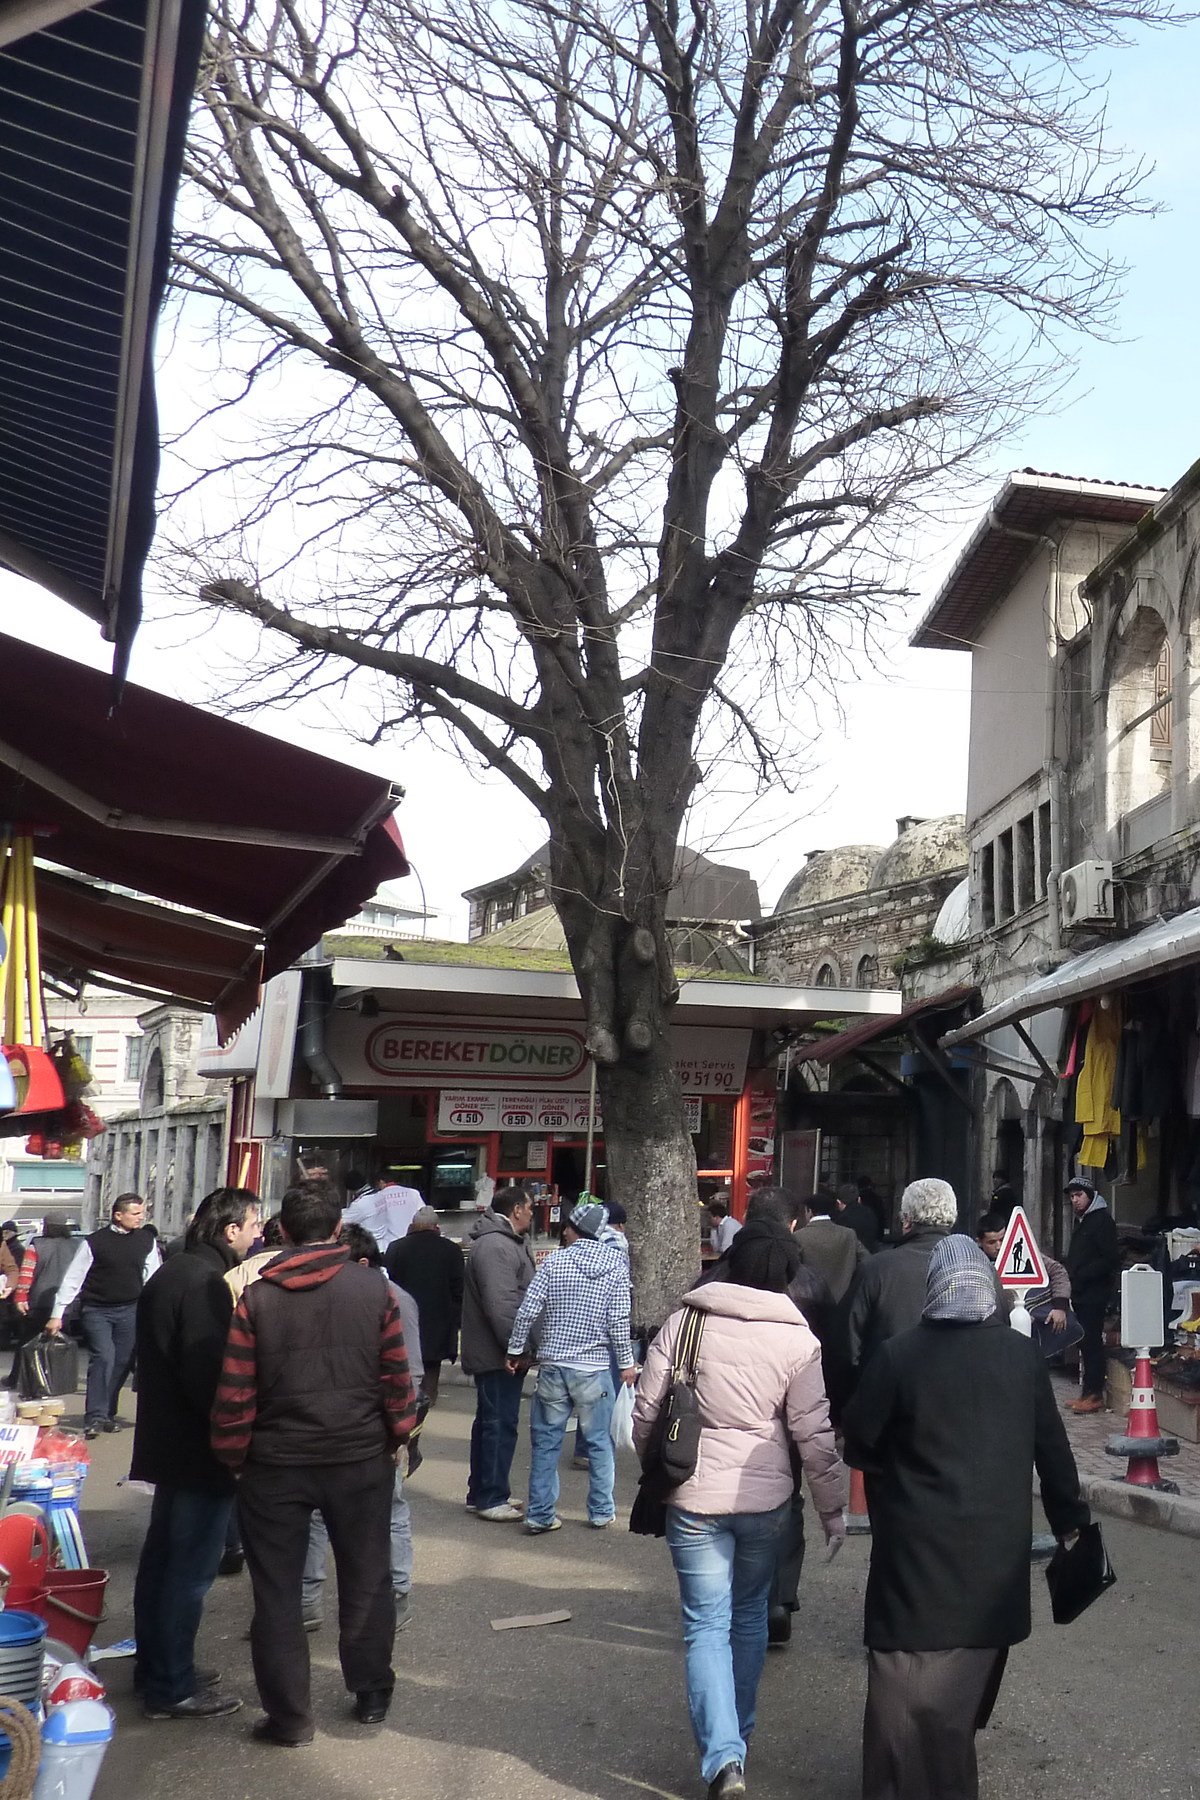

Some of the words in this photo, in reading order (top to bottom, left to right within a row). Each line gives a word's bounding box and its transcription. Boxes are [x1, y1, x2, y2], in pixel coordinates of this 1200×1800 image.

[702, 1060, 735, 1069] Servis
[714, 1073, 733, 1087] 90
[456, 1113, 478, 1123] 4.50
[507, 1115, 526, 1125] 8.50
[544, 1116, 562, 1126] 8.50
